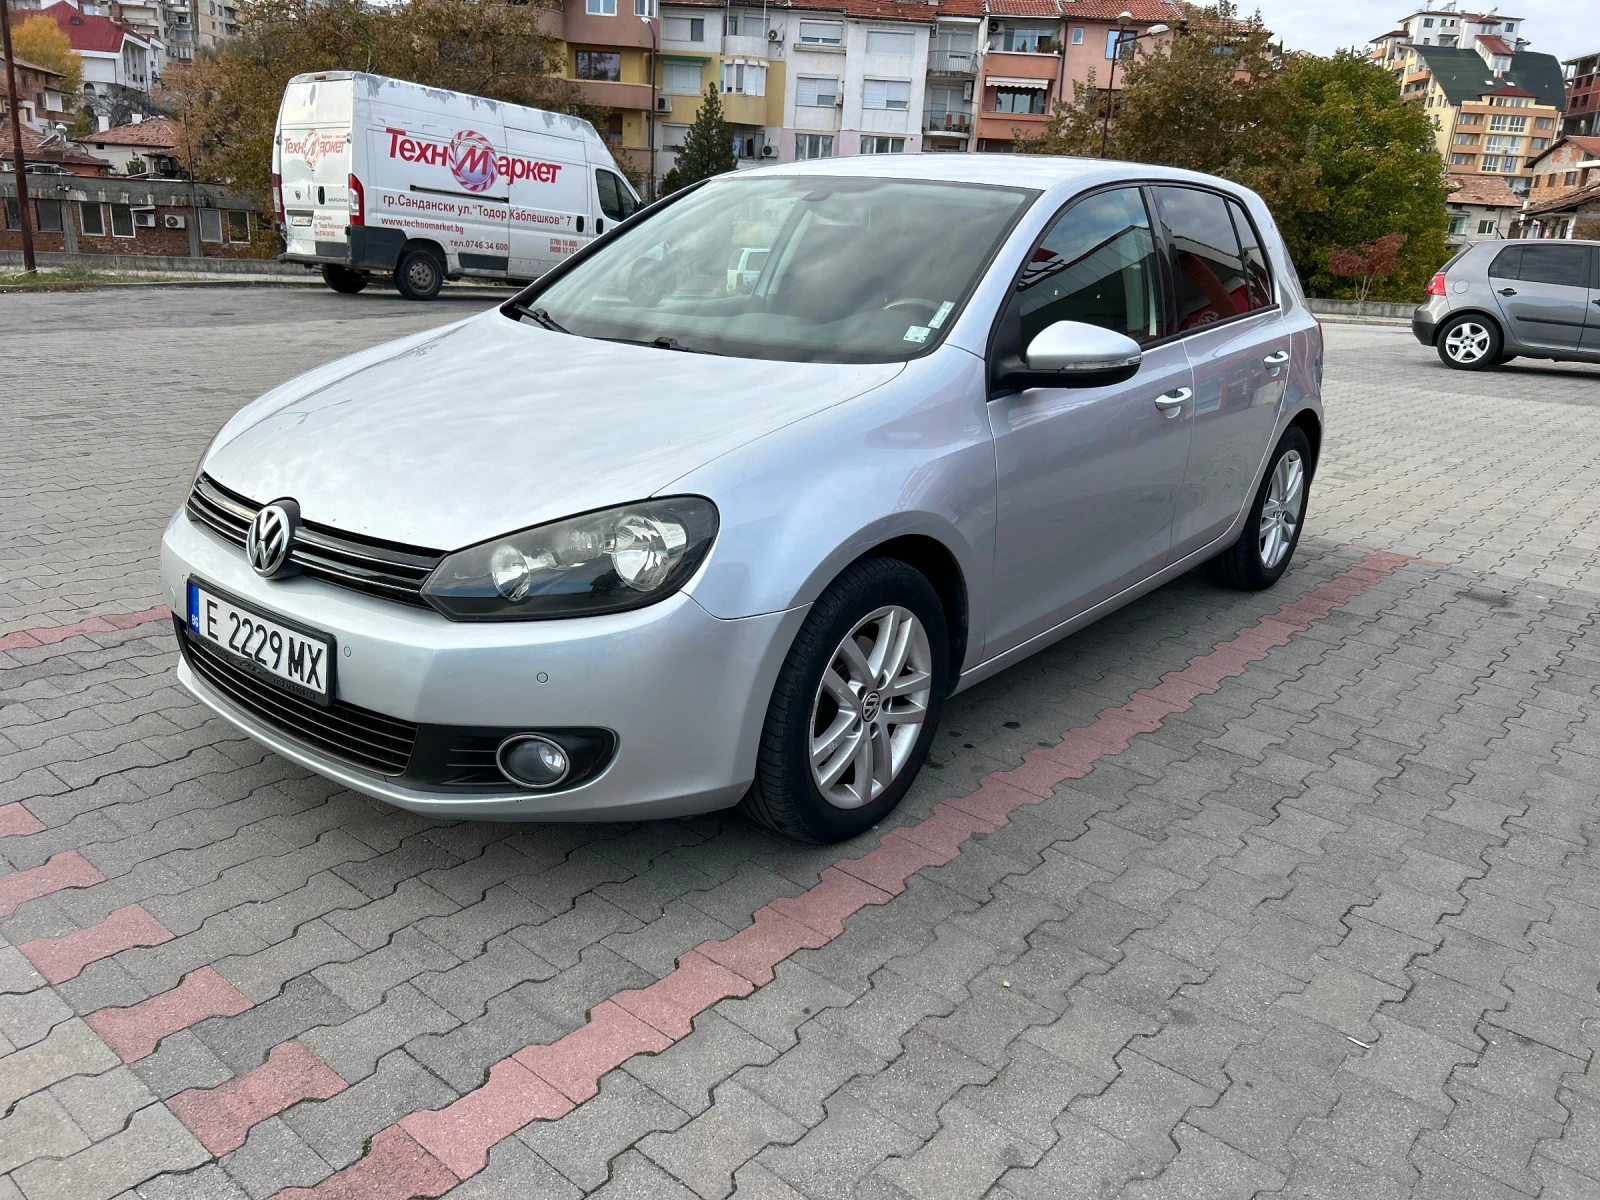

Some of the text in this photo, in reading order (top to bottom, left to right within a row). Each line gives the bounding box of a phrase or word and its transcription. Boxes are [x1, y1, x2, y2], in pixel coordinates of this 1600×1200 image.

[383, 194, 455, 213] гр.Сандански
[566, 216, 572, 227] 7
[381, 217, 464, 235] www.technomarket.bg
[449, 239, 508, 251] тел.0746 34 600
[191, 613, 199, 628] BG
[206, 599, 219, 641] E
[228, 611, 283, 671] 2229
[287, 636, 323, 689] MX
